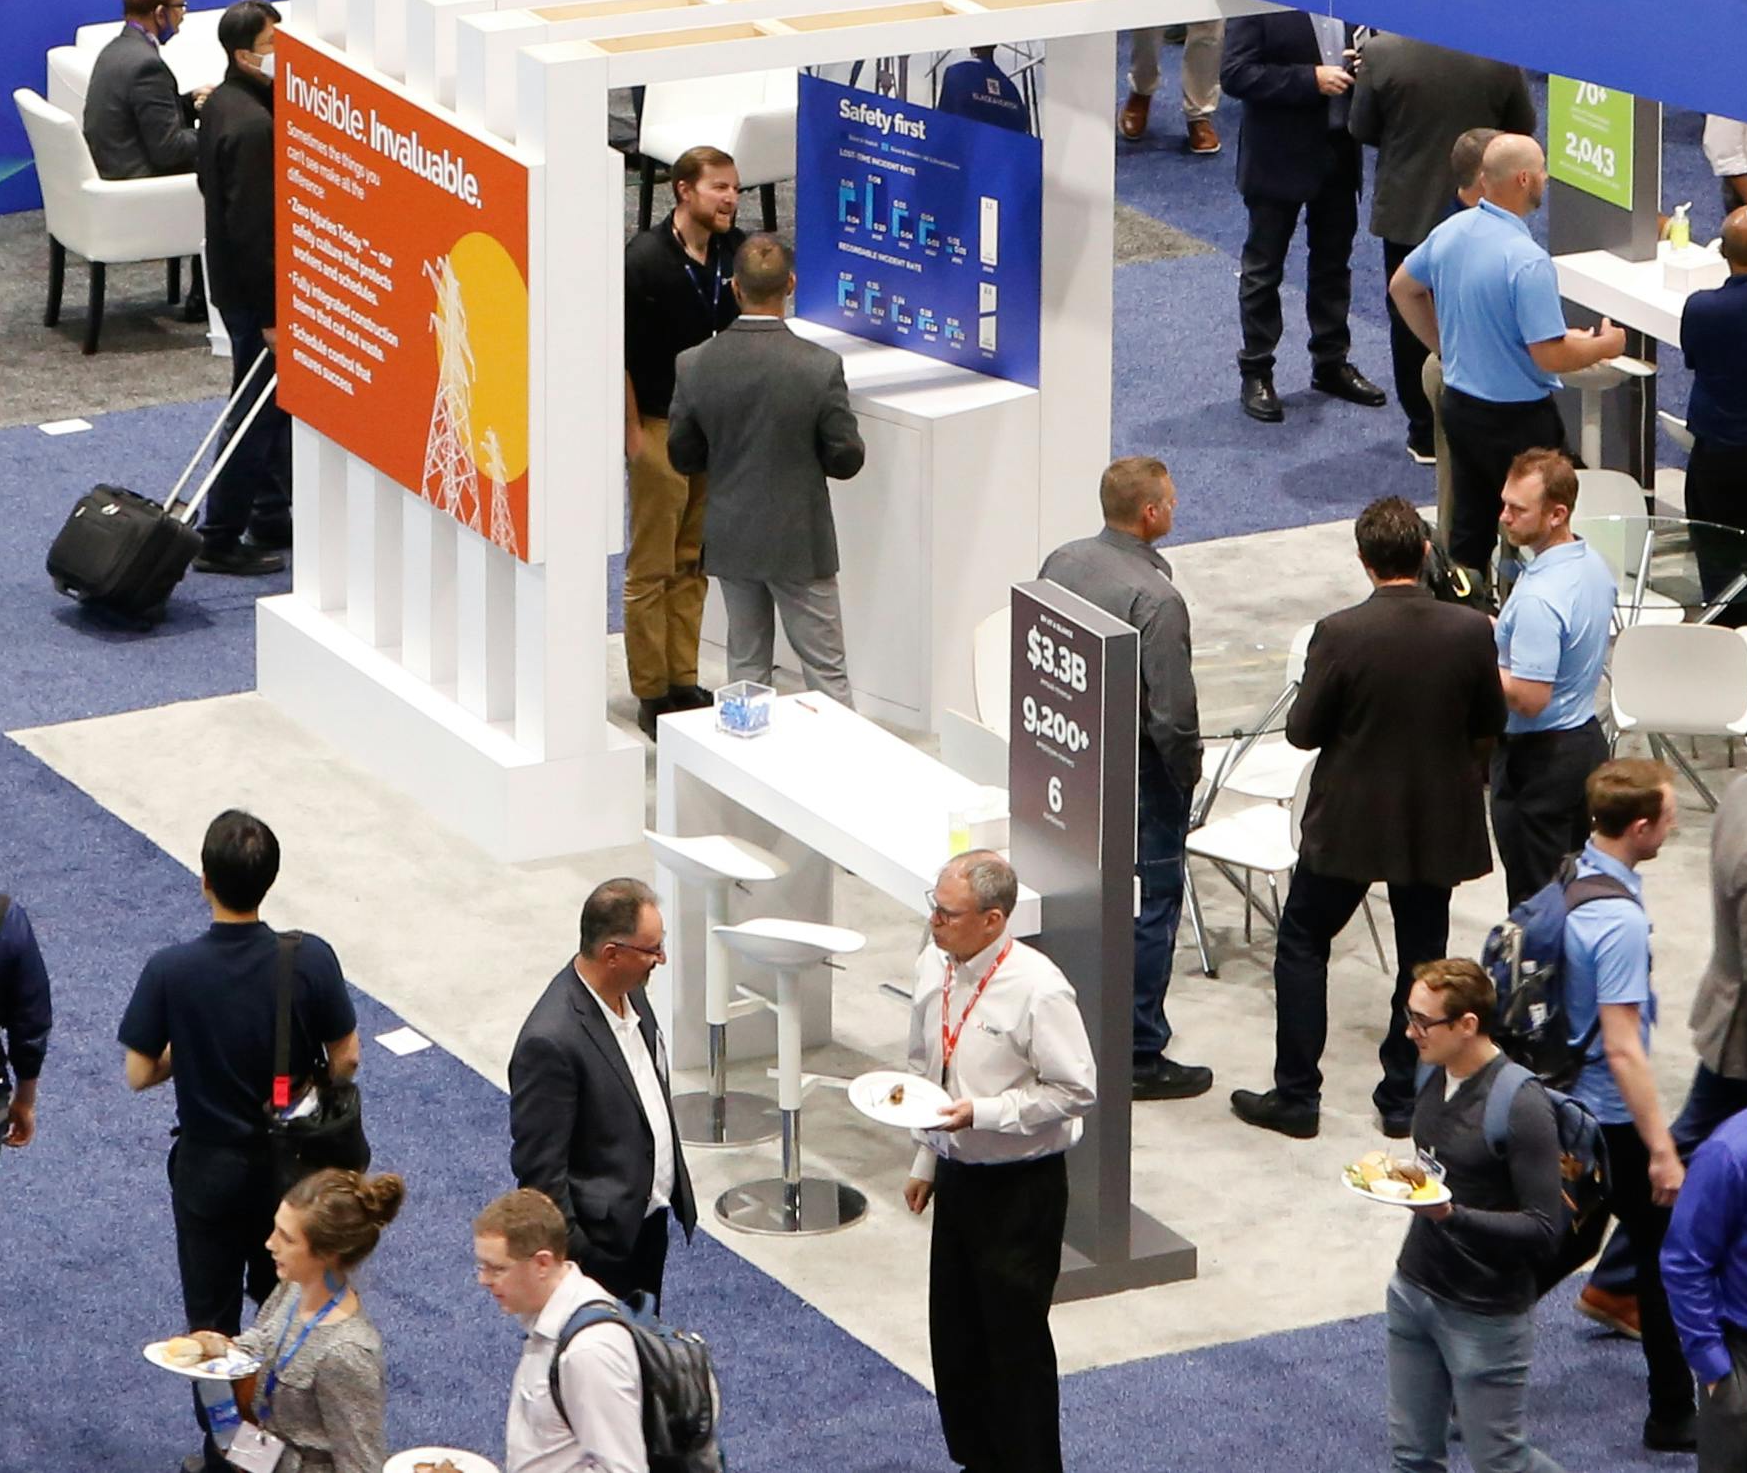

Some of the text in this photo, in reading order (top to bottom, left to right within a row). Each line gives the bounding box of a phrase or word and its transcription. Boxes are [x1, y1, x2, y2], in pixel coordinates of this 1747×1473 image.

[286, 62, 482, 209] Invisible. Invaluable.
[839, 98, 926, 140] Safety first
[328, 145, 341, 164] the
[342, 152, 366, 179] things
[366, 168, 381, 186] you
[1565, 132, 1615, 177] 2,043
[306, 156, 319, 173] see
[319, 165, 341, 186] make
[351, 181, 365, 200] the
[292, 222, 393, 292] safety culture that protects
[292, 244, 322, 272] workers
[322, 263, 338, 281] and
[311, 282, 350, 319] integrated
[351, 310, 399, 347] construction
[1026, 624, 1087, 693] $3.3B
[1022, 696, 1090, 752] 9,200+
[1047, 776, 1063, 813] 6
